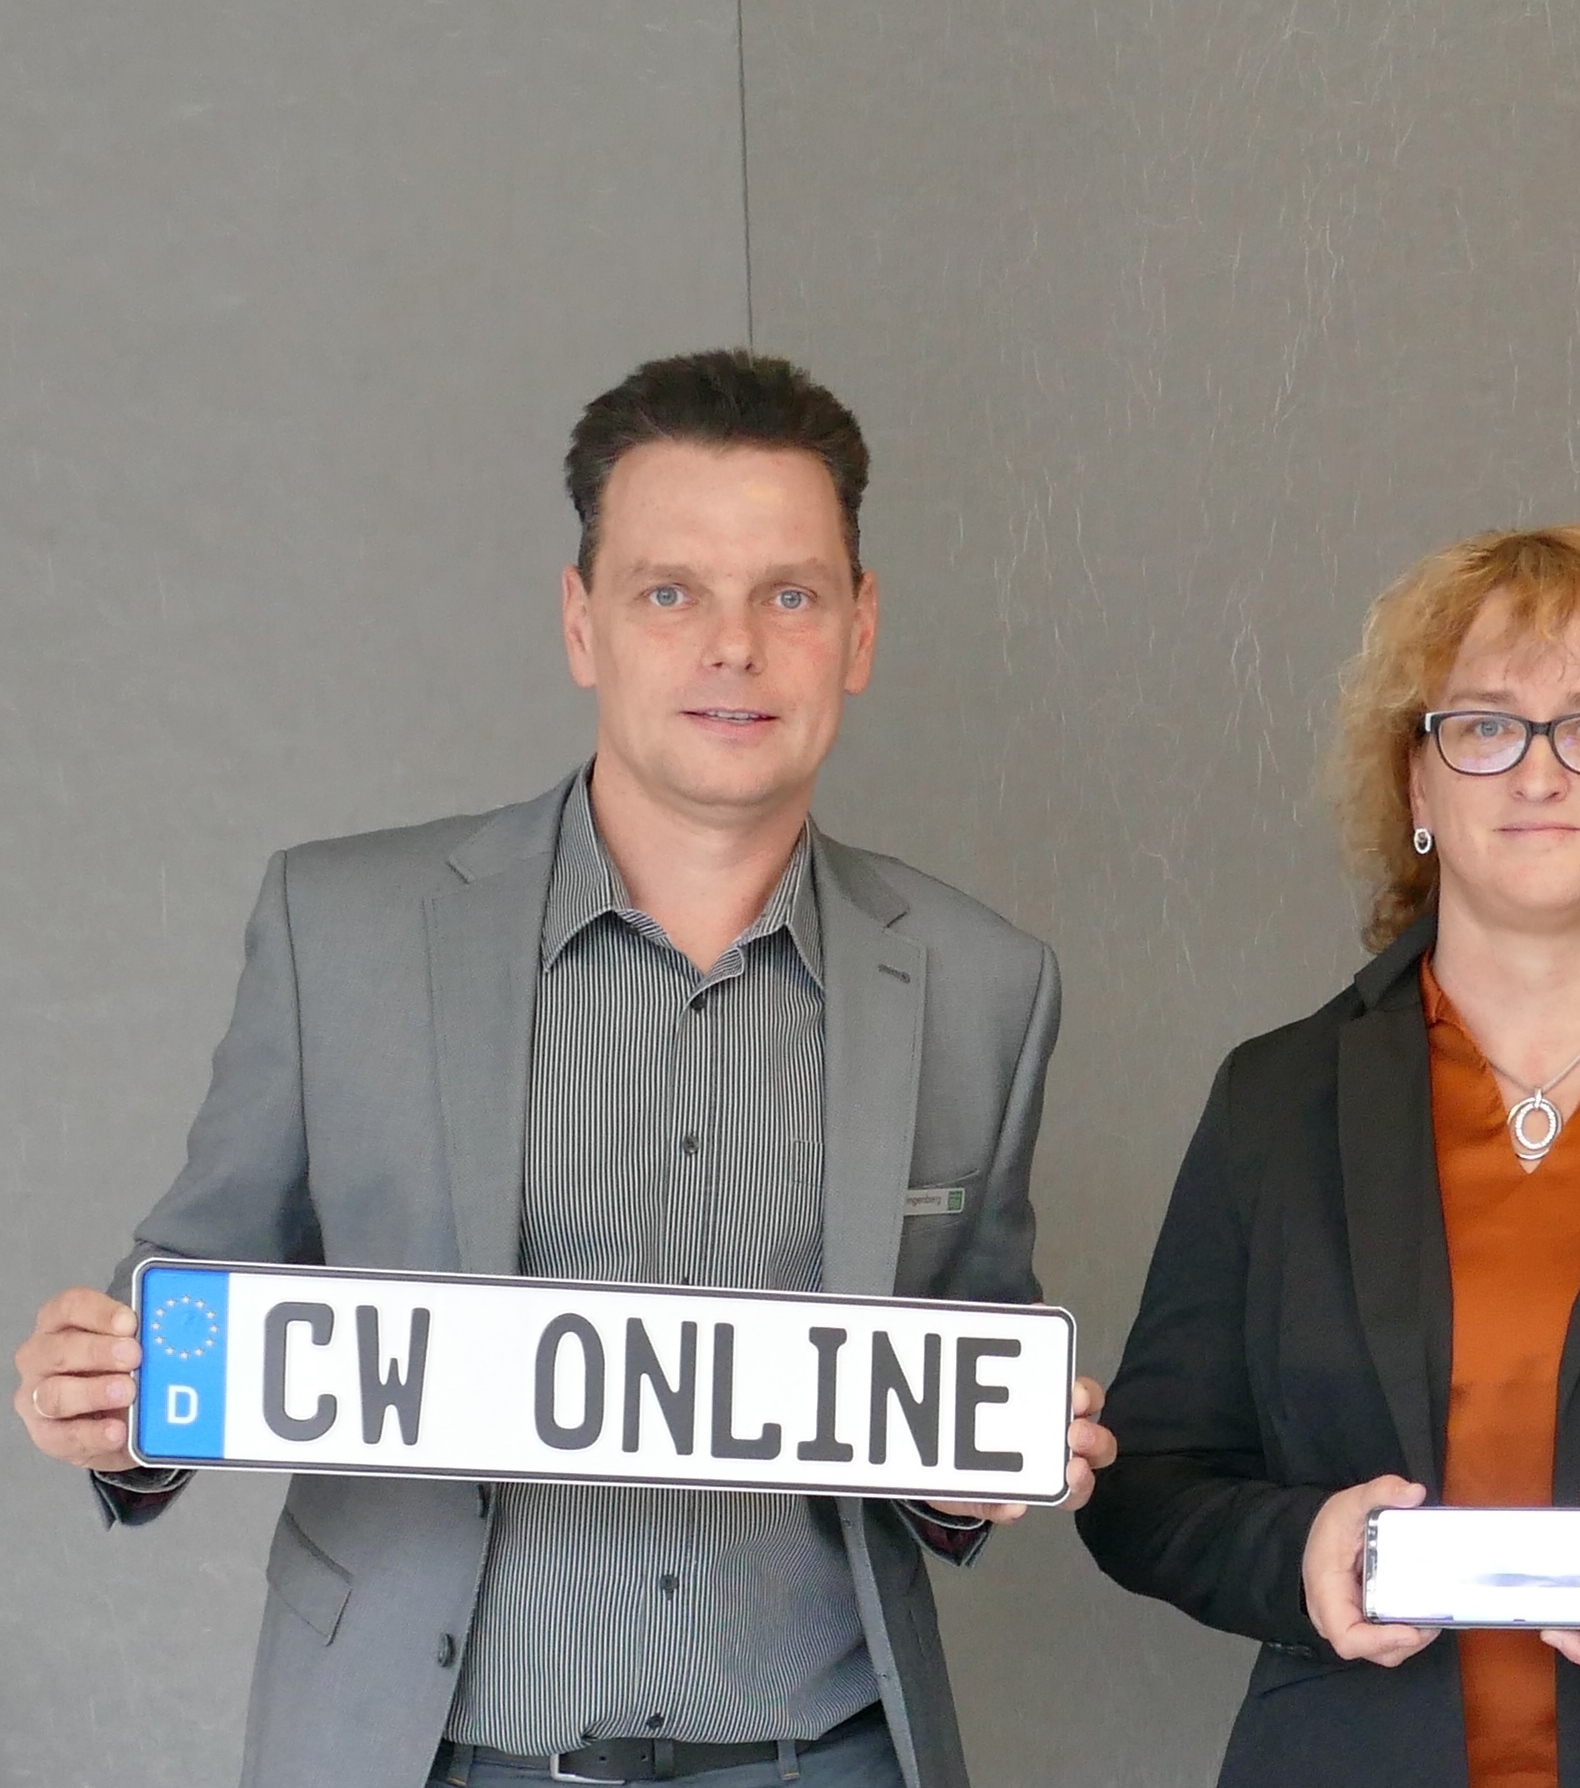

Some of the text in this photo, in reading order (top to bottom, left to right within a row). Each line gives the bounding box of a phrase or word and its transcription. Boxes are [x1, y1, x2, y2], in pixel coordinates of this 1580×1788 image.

[167, 1384, 198, 1424] D
[261, 1301, 1025, 1474] CW ONLINE
